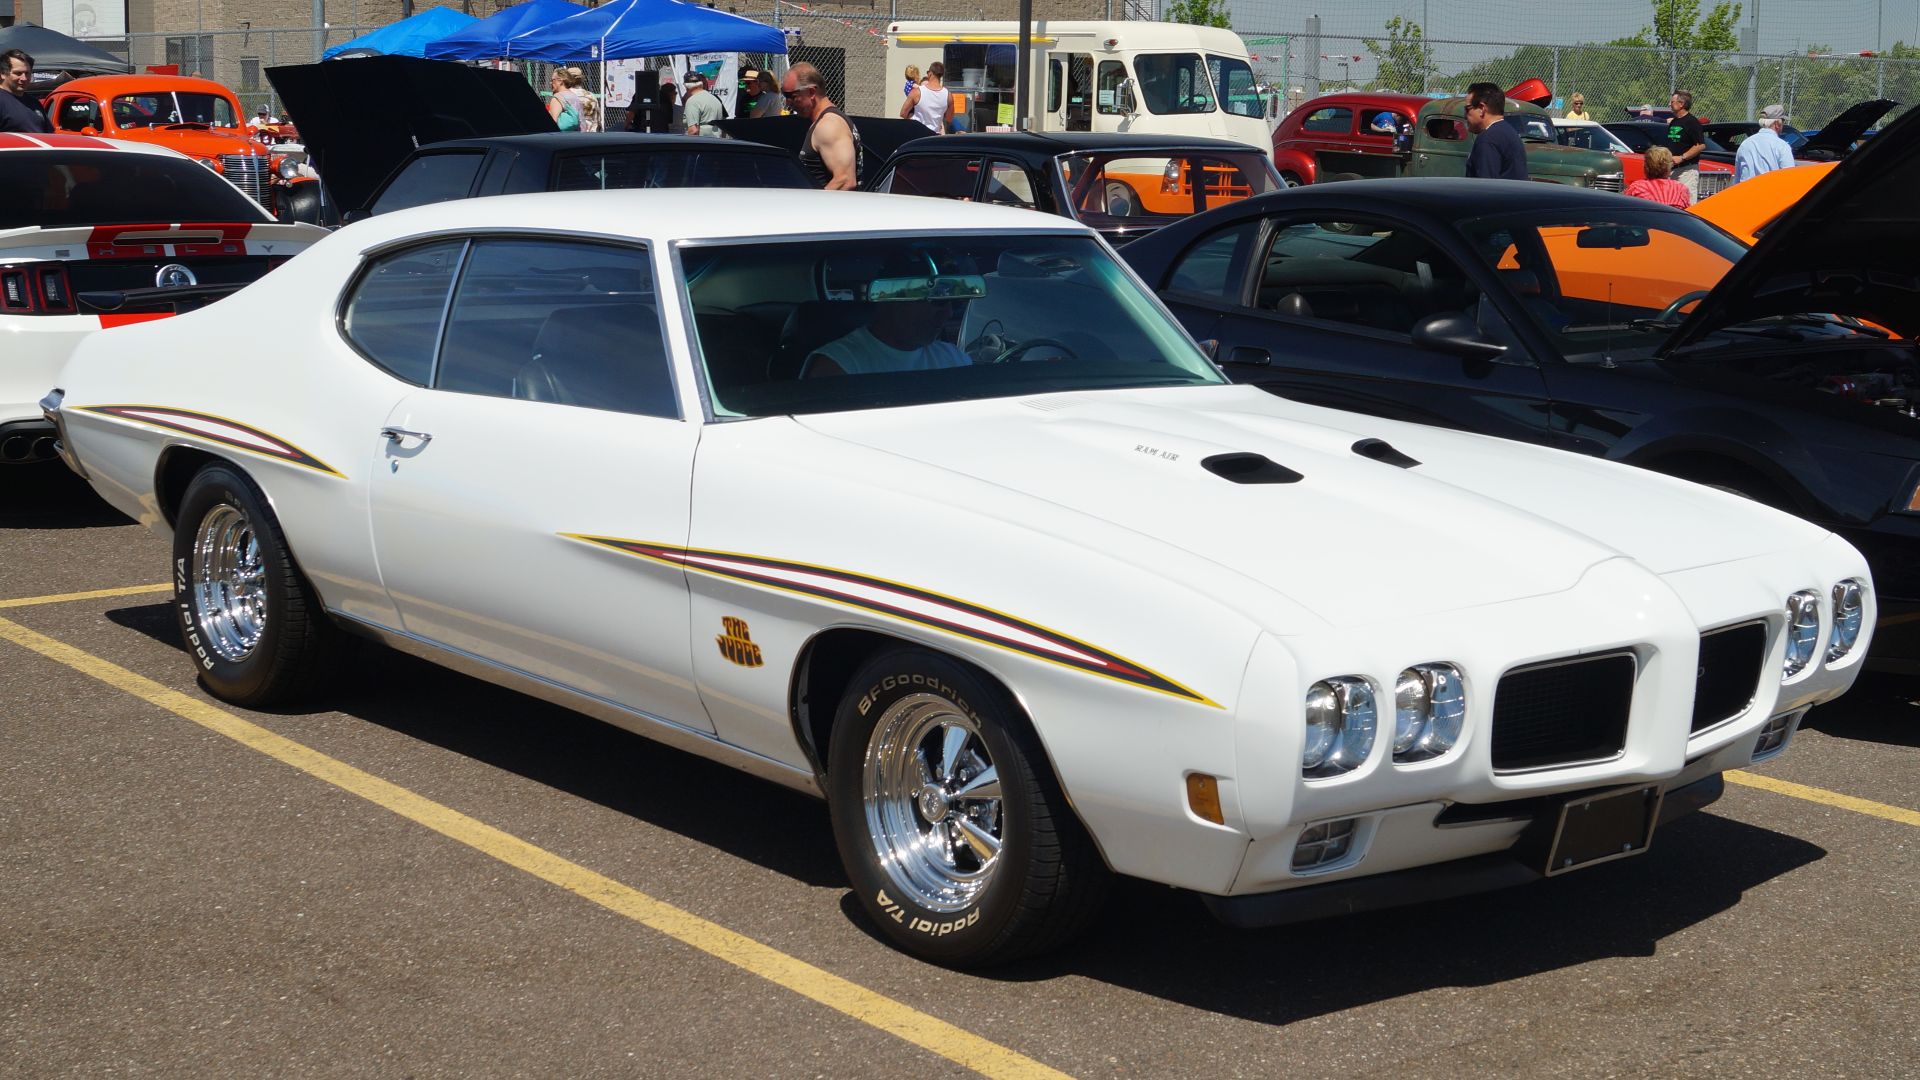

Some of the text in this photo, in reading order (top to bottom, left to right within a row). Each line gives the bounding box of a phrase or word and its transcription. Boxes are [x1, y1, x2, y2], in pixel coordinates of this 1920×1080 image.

[55, 243, 274, 258] SHELBY
[1135, 445, 1179, 461] RAM AIR
[177, 558, 214, 670] Radial T/A
[721, 616, 751, 642] THE
[857, 672, 983, 730] BFGoodrich
[875, 887, 981, 938] Radial T/A
